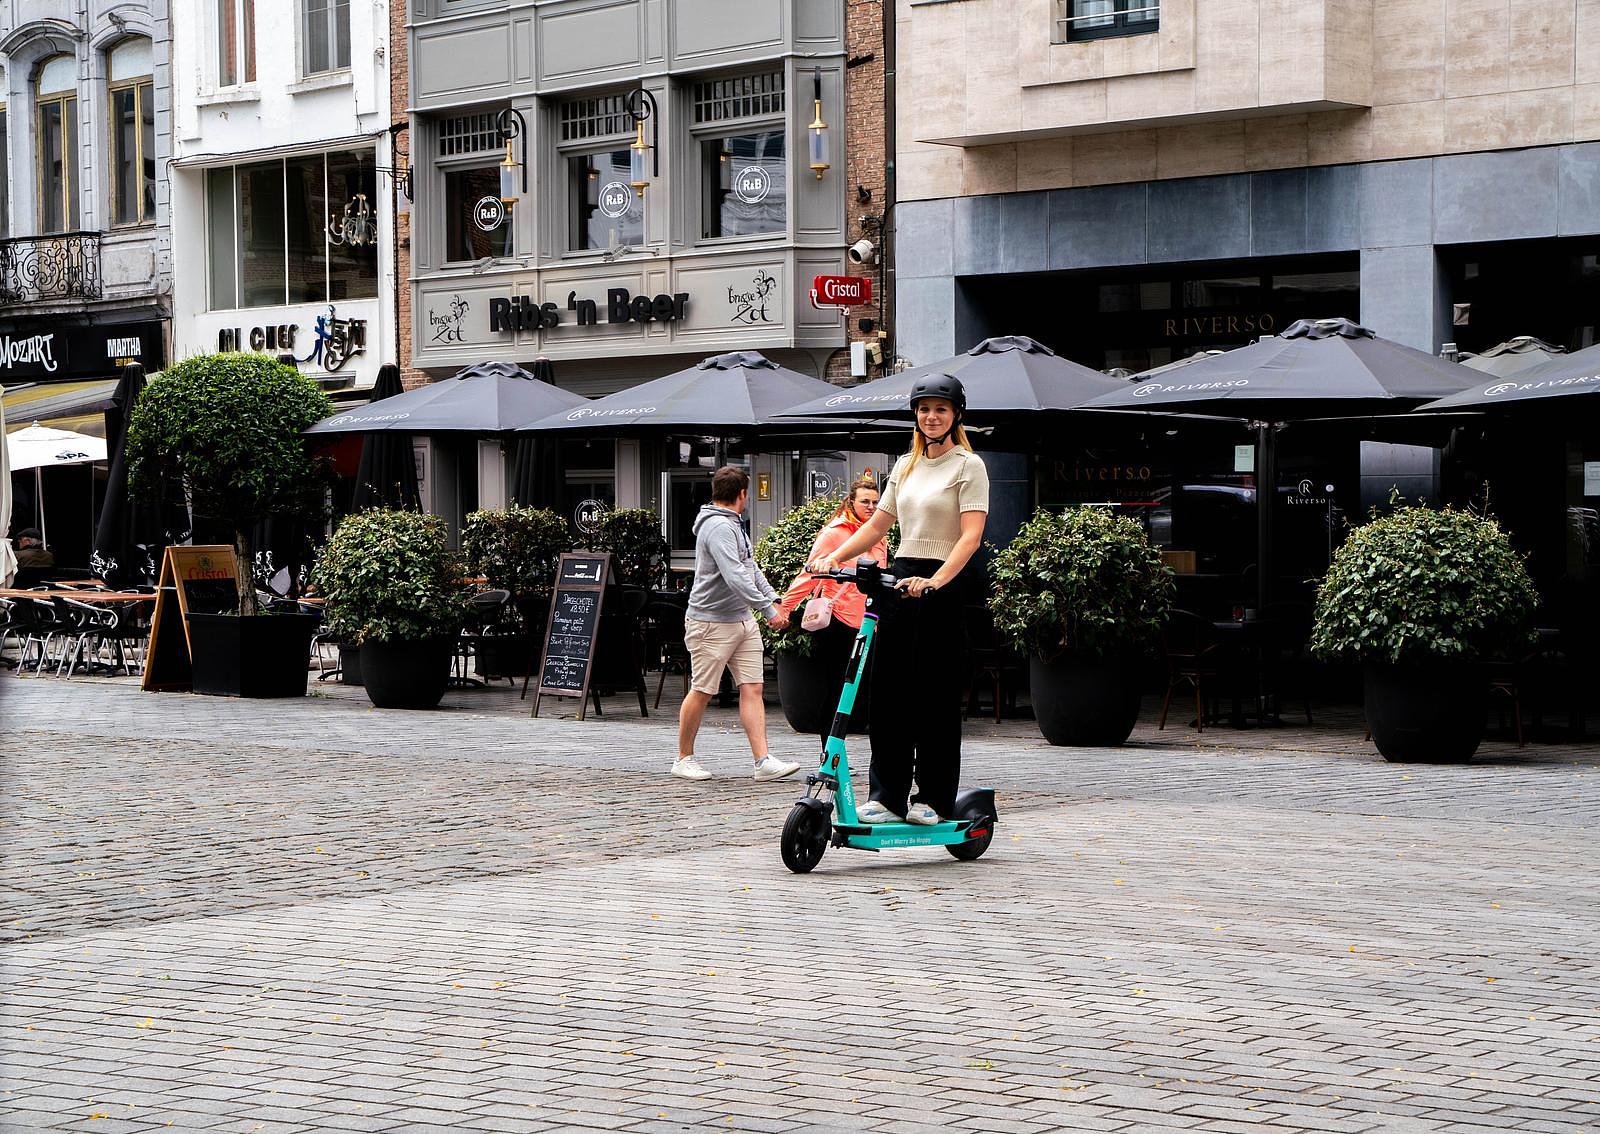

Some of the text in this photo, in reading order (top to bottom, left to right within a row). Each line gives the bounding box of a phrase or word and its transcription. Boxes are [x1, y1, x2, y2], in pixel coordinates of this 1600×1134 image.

[743, 178, 762, 190] R&B
[606, 194, 624, 205] R&B
[481, 208, 497, 219] R&B
[825, 279, 860, 299] Cristal
[489, 297, 558, 332] Ribs
[607, 288, 690, 324] Beer
[731, 304, 774, 324] Zot
[1166, 313, 1274, 336] RIVERSO
[107, 337, 141, 358] MARTHA
[1163, 379, 1249, 392] RIVERSO
[1519, 375, 1600, 390] RIVERS
[590, 406, 656, 416] RIVERSO
[55, 452, 89, 460] SPA
[1054, 460, 1151, 481] Riverso
[1287, 495, 1326, 505] Riverso
